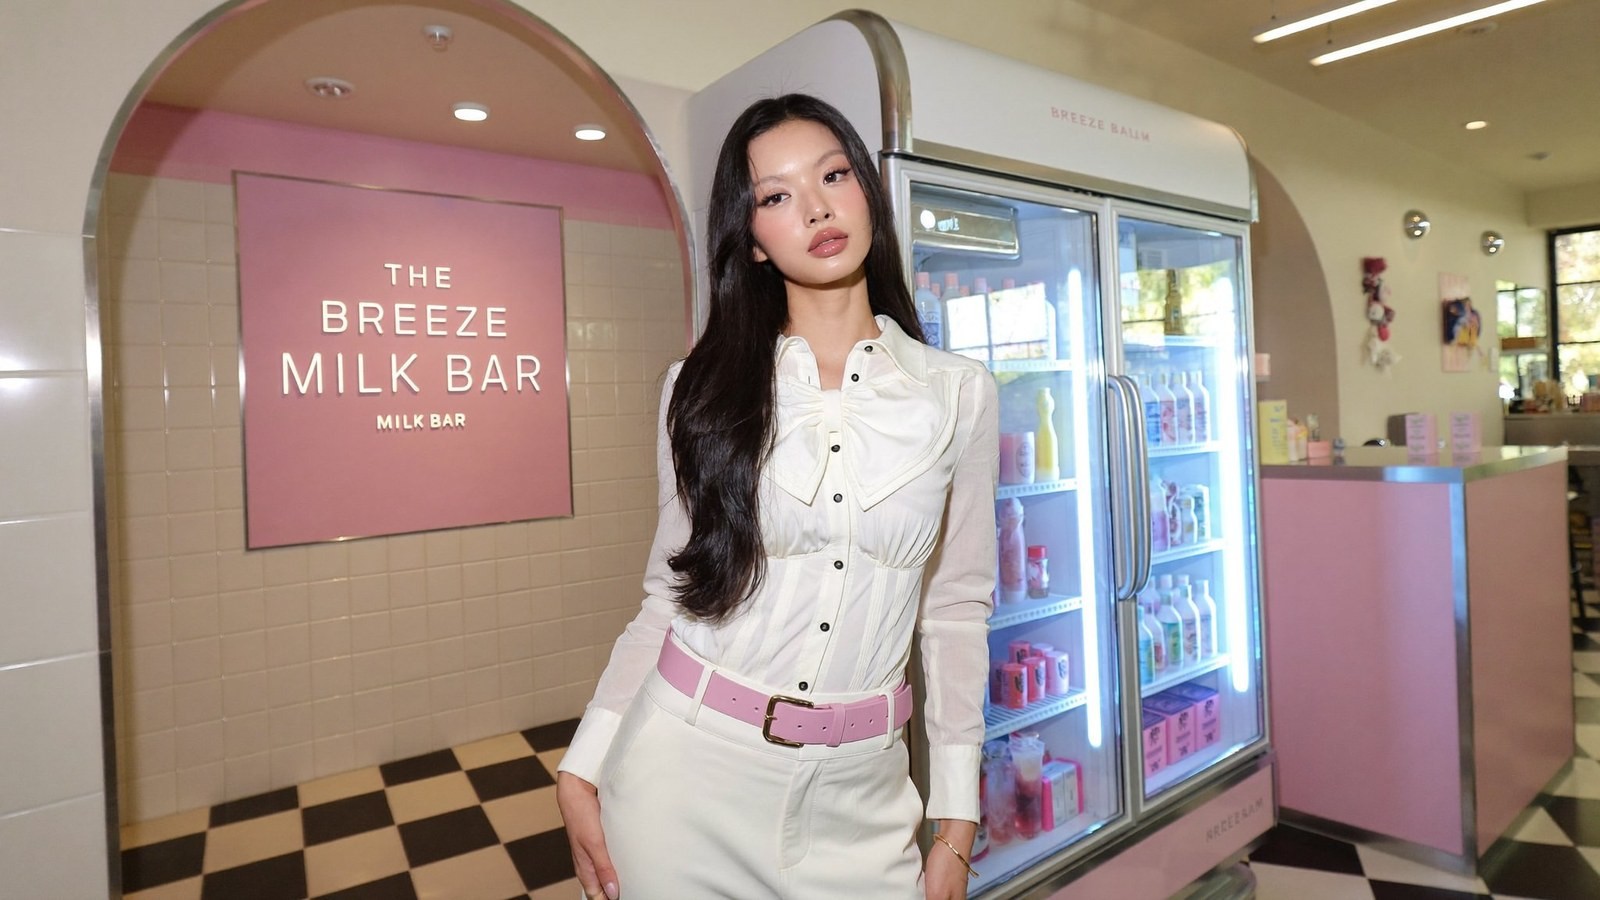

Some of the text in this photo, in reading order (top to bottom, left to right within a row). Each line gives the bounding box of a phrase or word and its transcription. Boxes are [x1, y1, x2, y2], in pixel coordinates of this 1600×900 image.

[1050, 106, 1105, 130] BREEZE
[384, 263, 451, 288] THE
[321, 300, 507, 337] BREEZE
[281, 352, 541, 394] MILK BAR
[376, 413, 466, 430] MILK BAR
